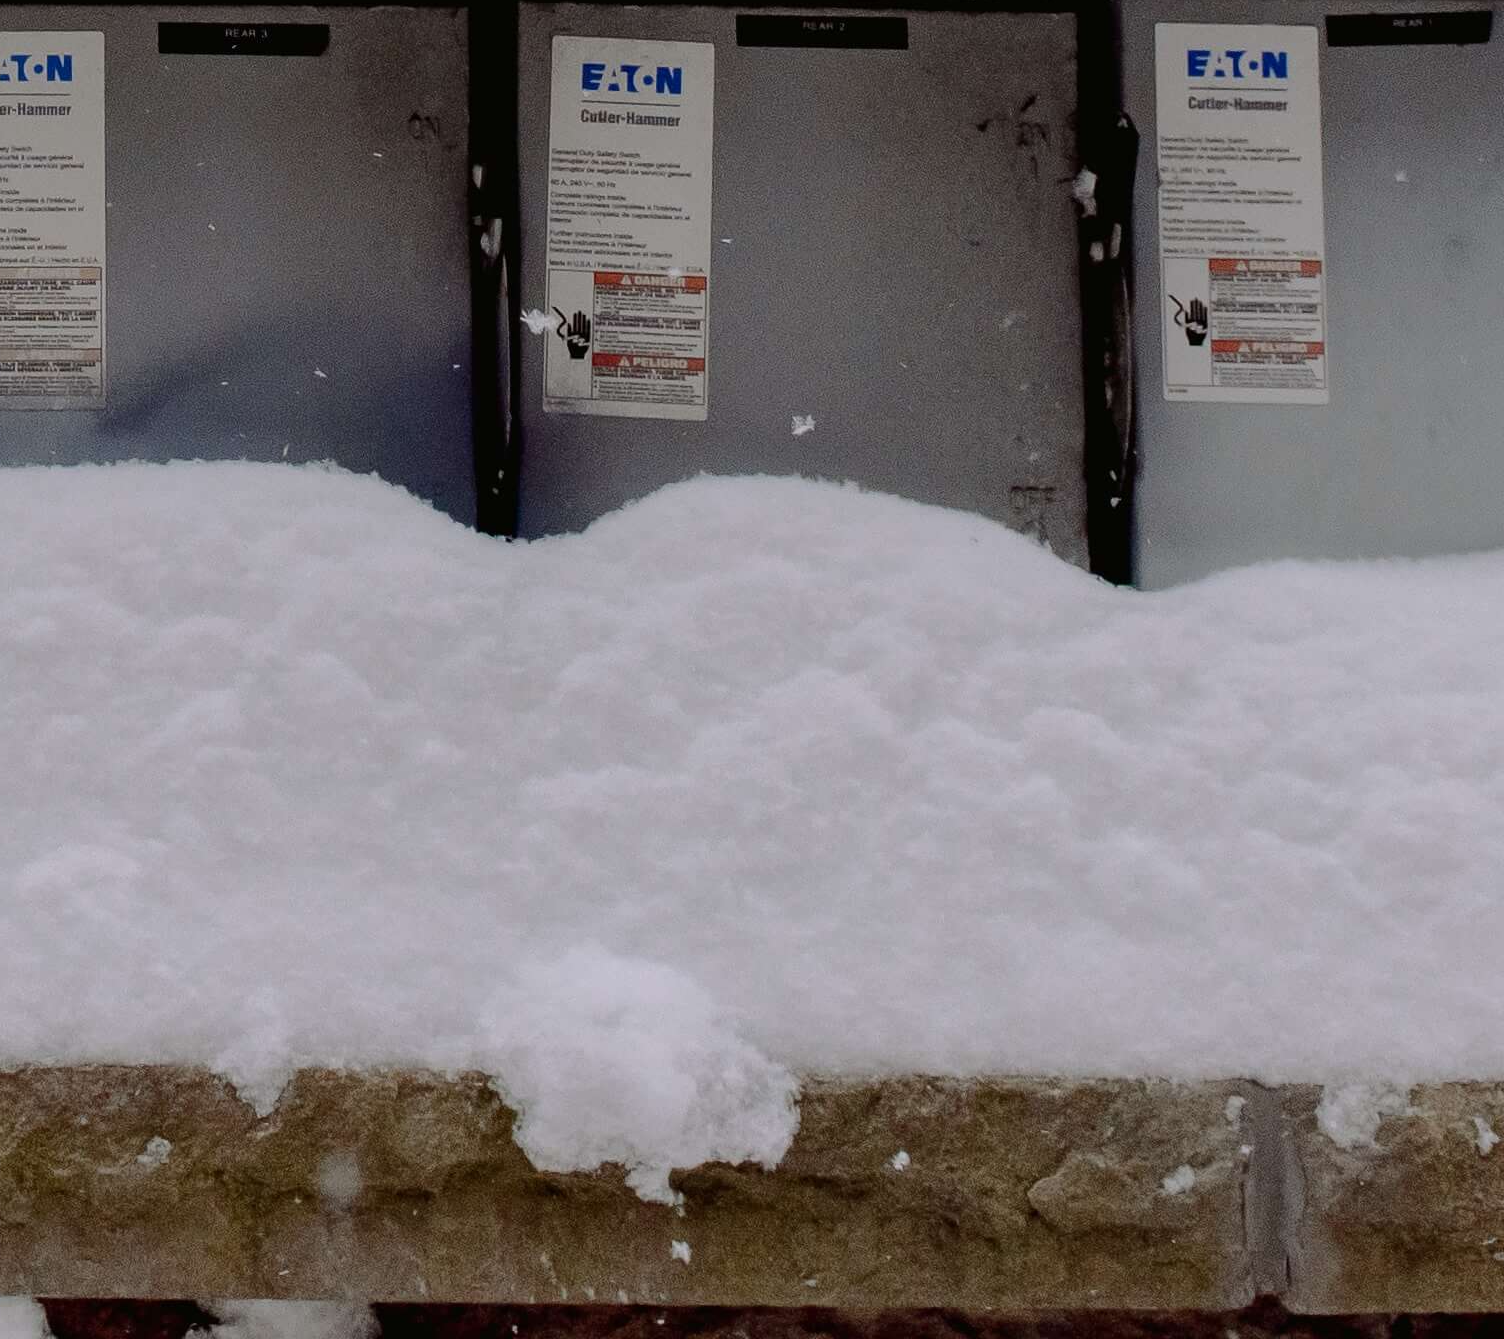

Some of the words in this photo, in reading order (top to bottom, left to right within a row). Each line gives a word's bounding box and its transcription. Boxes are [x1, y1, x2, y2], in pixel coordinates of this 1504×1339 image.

[224, 27, 256, 38] REAR
[1187, 50, 1288, 79] EATON
[581, 63, 683, 95] EATON
[1188, 96, 1288, 111] Cutler-Hammer
[580, 108, 681, 128] Cutler-Hammer
[632, 358, 687, 369] PELIGRO
